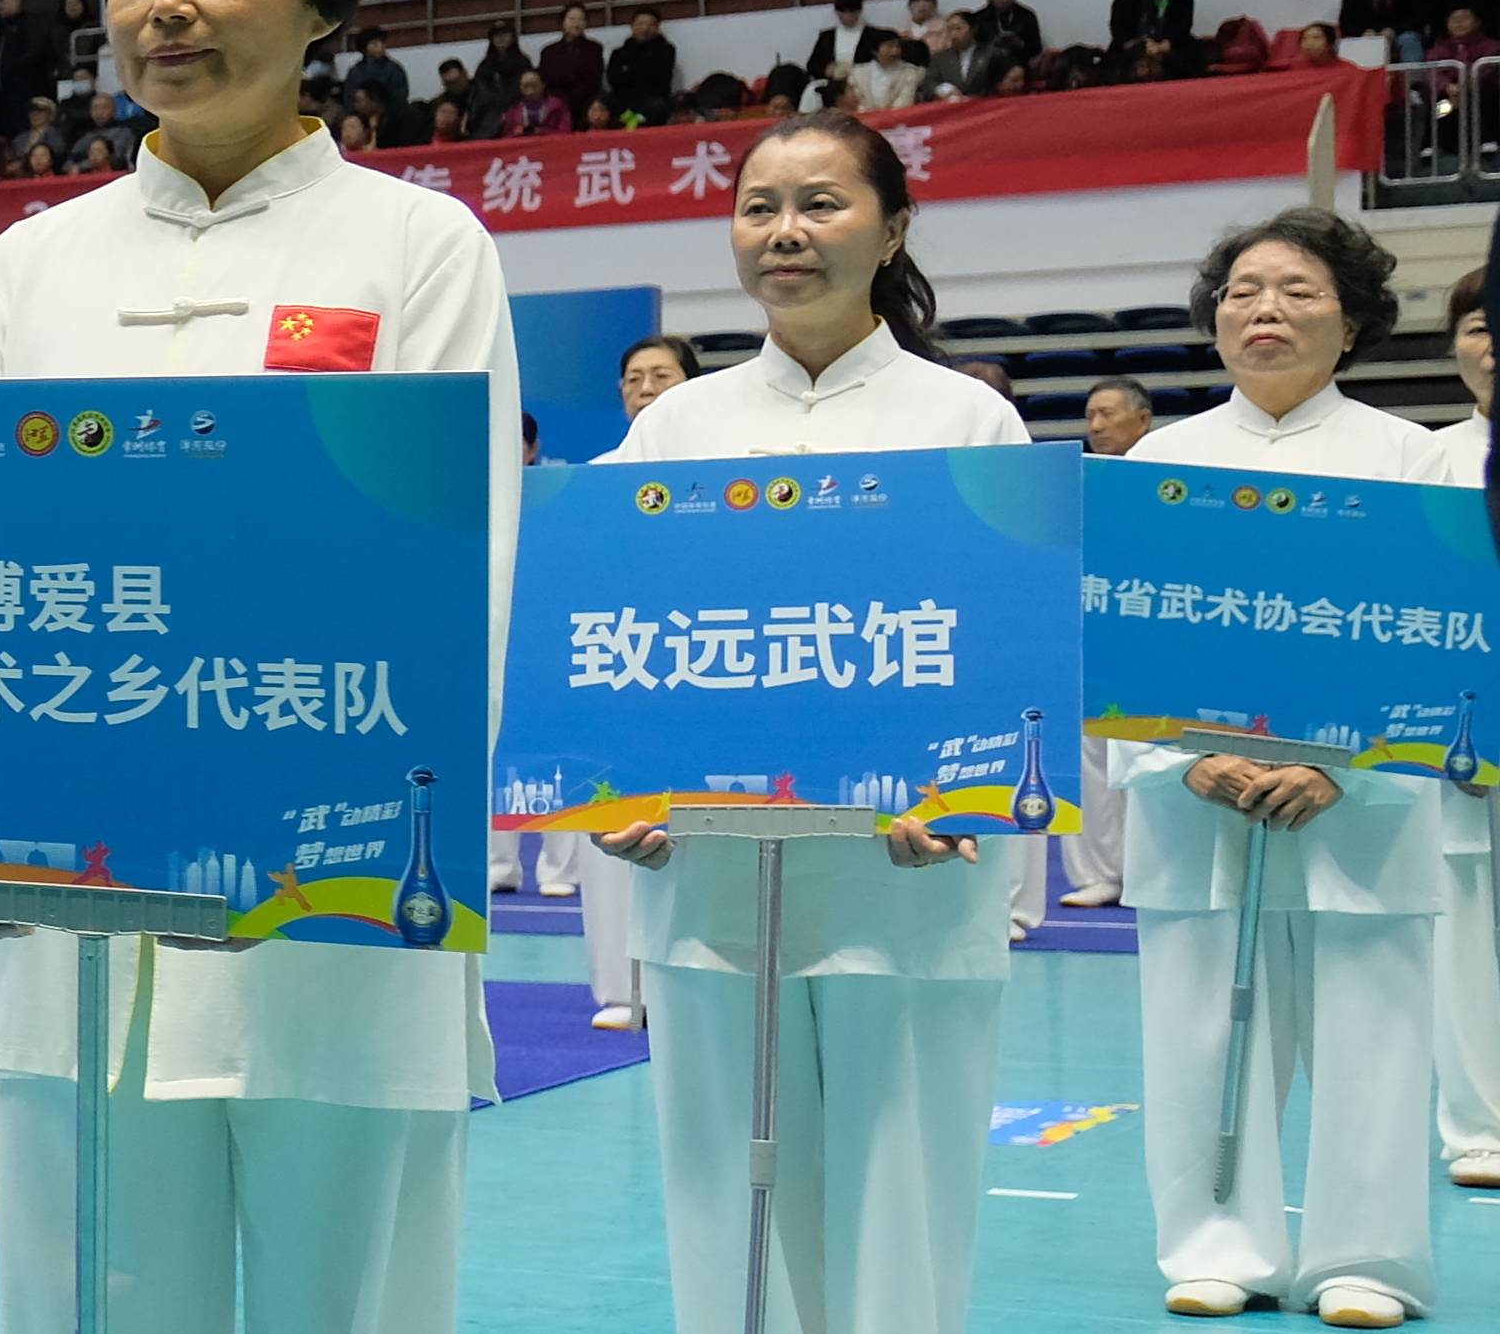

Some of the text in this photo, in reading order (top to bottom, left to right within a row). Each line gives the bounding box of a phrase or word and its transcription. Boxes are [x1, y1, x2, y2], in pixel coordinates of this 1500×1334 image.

[568, 598, 958, 692] 致远武馆
[1081, 573, 1493, 654] 肃省武术协会代表队
